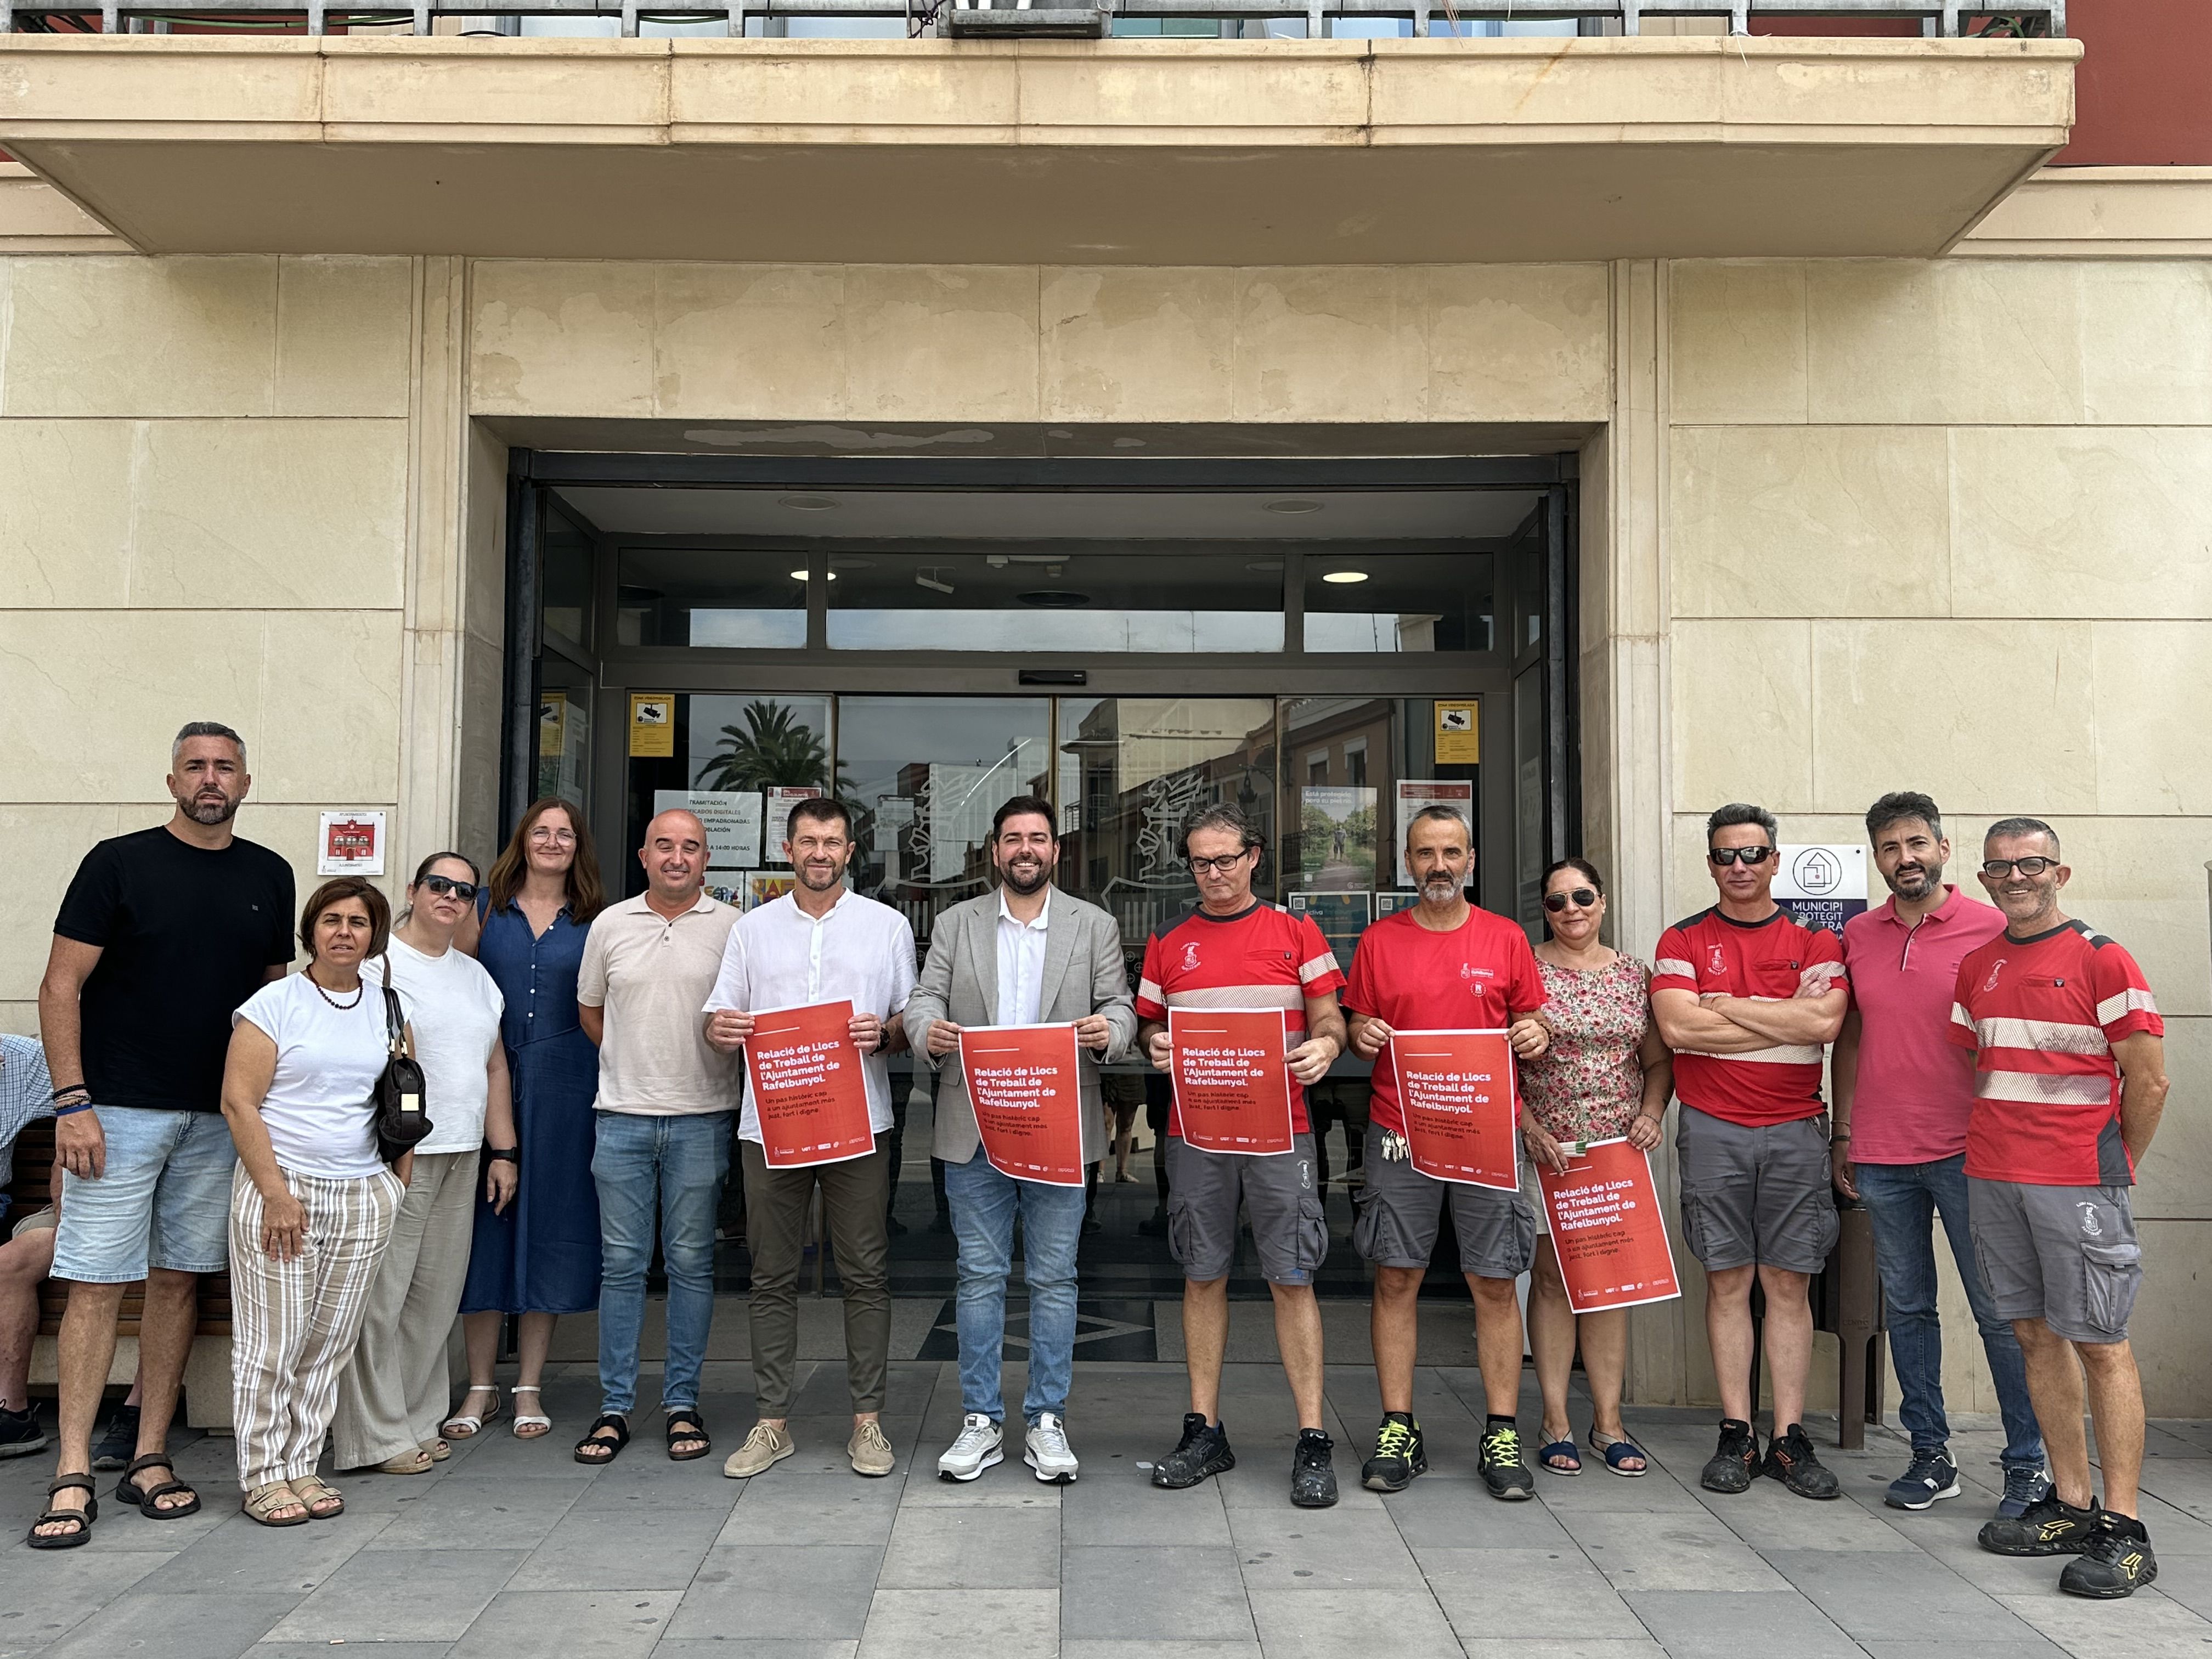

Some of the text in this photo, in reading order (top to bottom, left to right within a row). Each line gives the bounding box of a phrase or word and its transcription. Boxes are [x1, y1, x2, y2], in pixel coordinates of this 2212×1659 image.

[1792, 901, 1843, 911] MUNICIPI
[1795, 911, 1843, 921] ROTEGIT
[757, 1041, 839, 1060] Relació de Llocs
[1182, 1048, 1266, 1057] Relació de Llocs
[759, 1053, 825, 1070] de Treball de
[1183, 1058, 1250, 1066] de Treball de
[760, 1062, 840, 1081] l'Ajuntament de
[974, 1066, 1058, 1076] Relació de Llocs
[1183, 1068, 1248, 1077] l'Ajuntament
[1406, 1071, 1491, 1081] Relació de Llocs
[976, 1077, 1042, 1087] de Treball de
[1407, 1081, 1475, 1092] de Treball de
[977, 1087, 1056, 1098] l'Ajuntament de
[1409, 1089, 1489, 1103] l'Ajuntament de
[1554, 1180, 1633, 1200] Relació de Llocs
[1556, 1192, 1620, 1210] de Treball de
[1558, 1200, 1636, 1221] l'Ajuntament de
